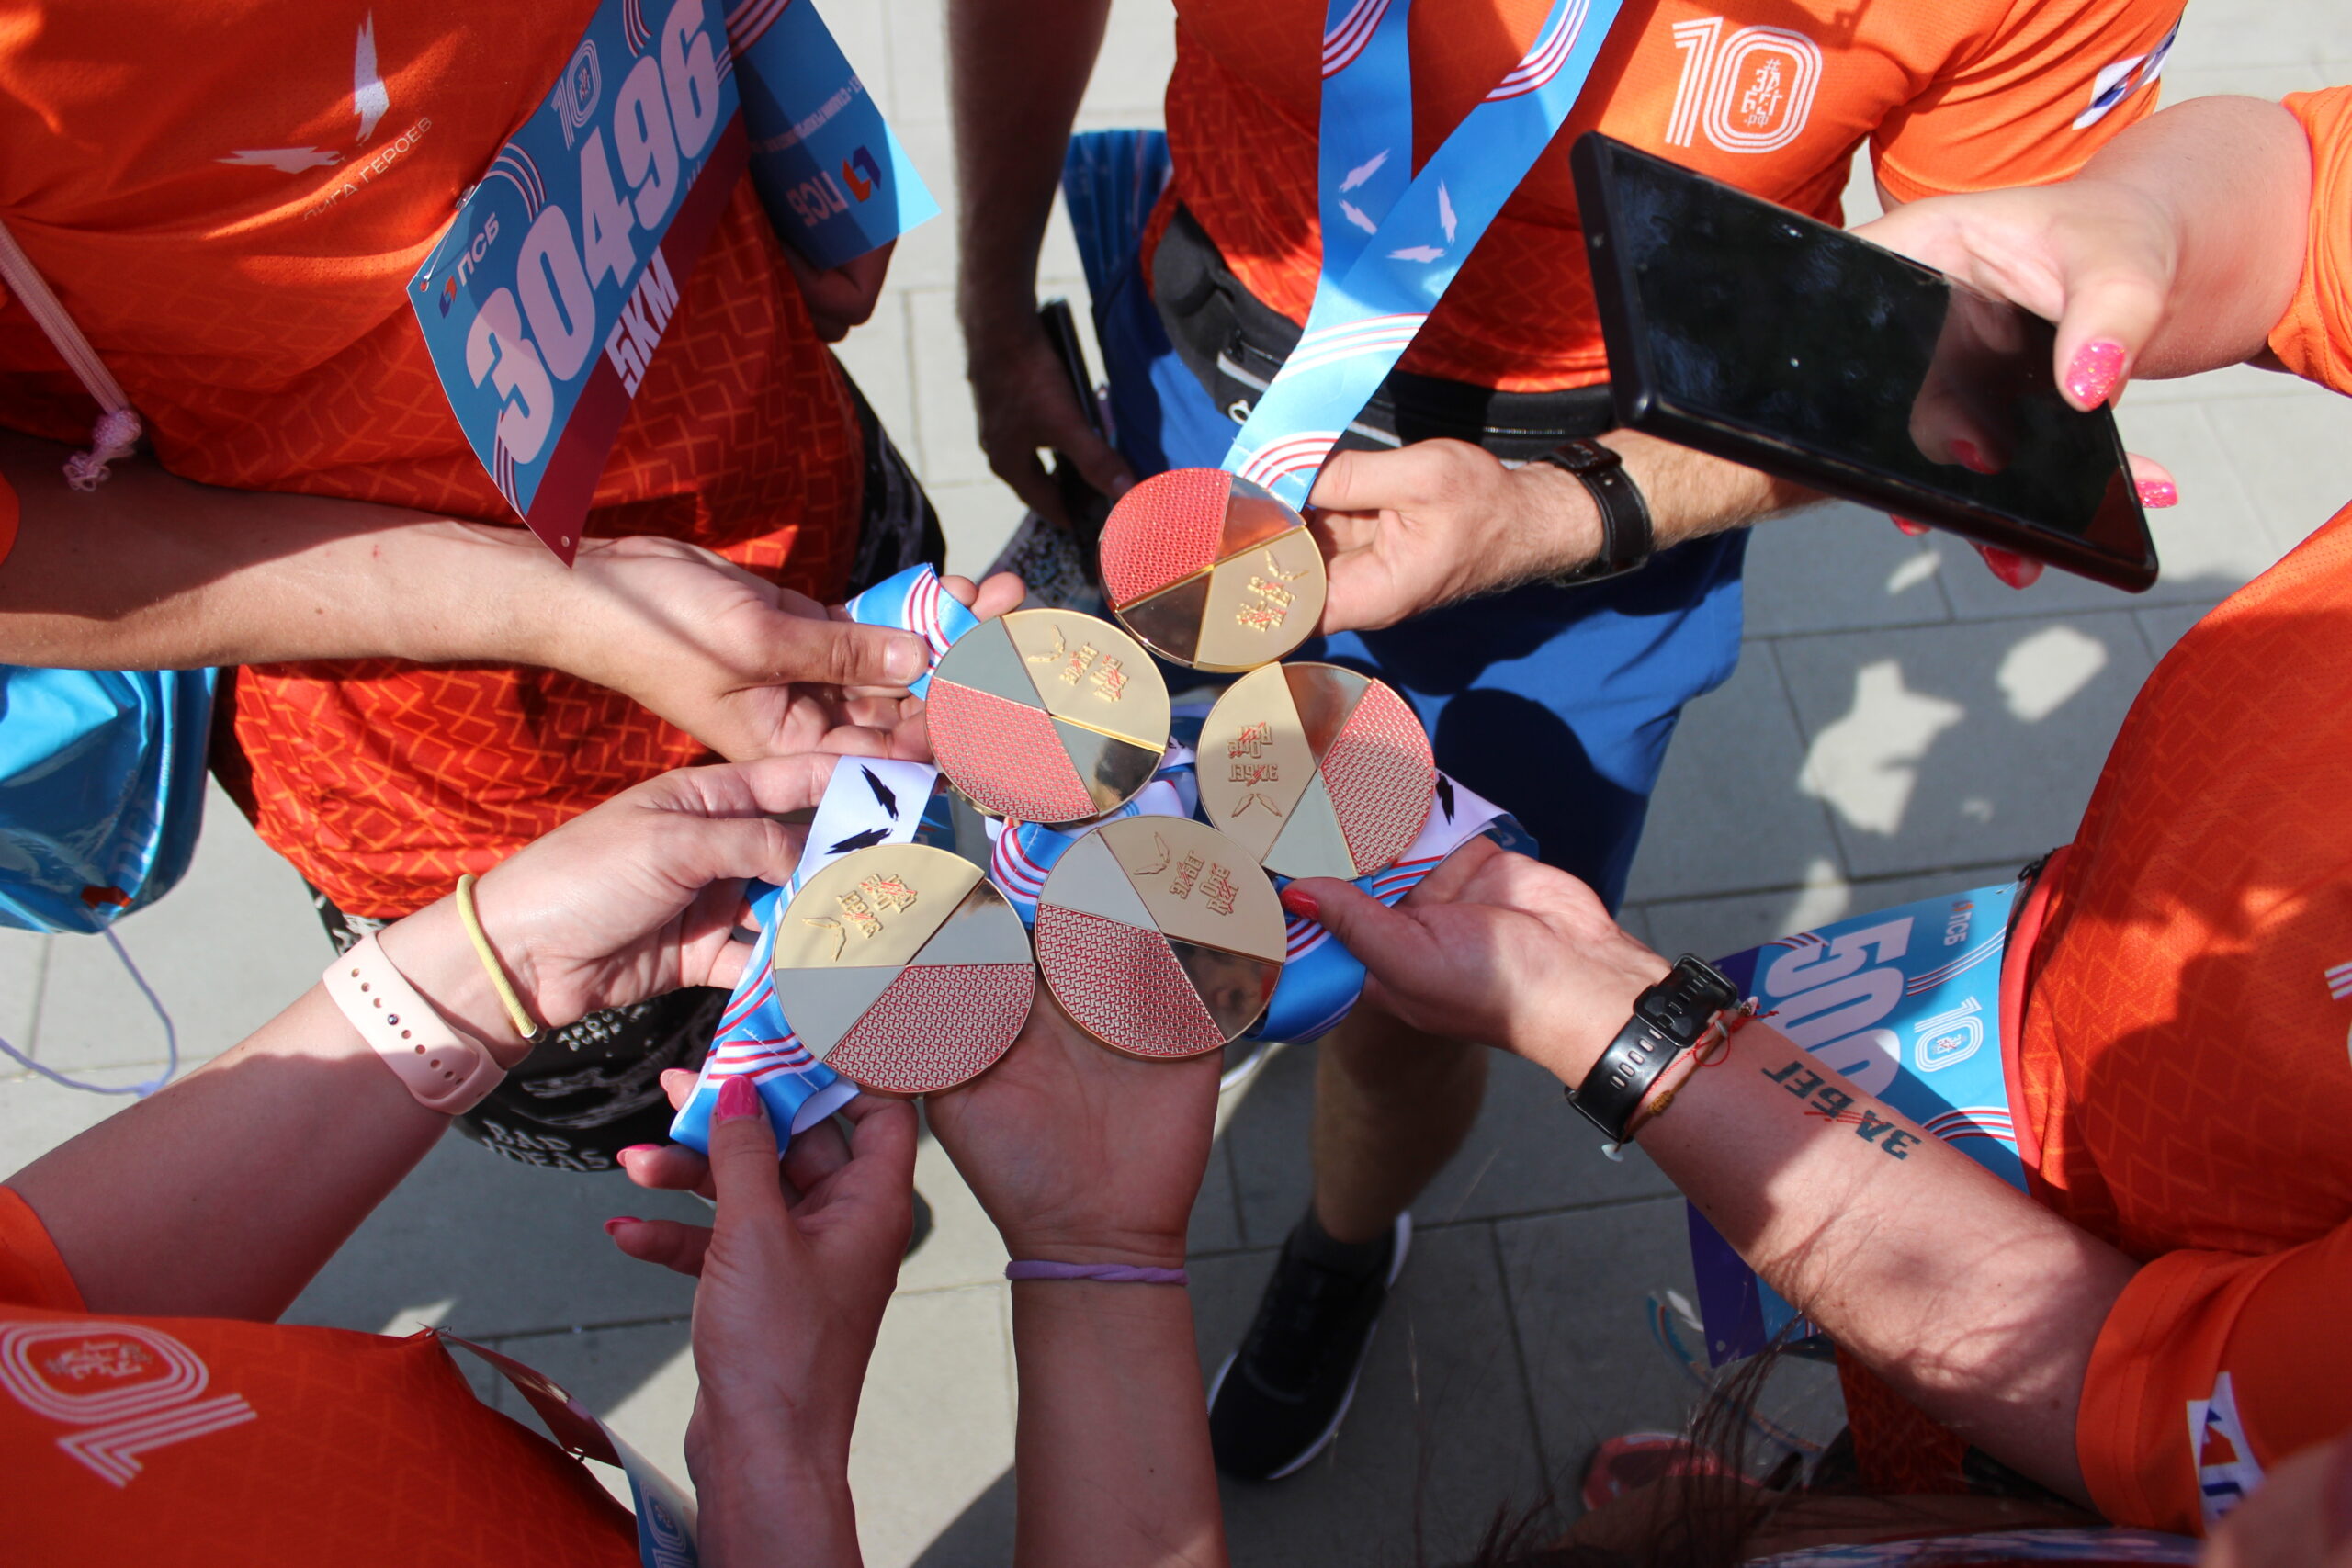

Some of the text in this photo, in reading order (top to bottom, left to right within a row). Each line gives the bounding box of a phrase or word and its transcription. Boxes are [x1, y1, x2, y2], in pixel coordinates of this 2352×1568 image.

[1665, 16, 1823, 154] 10
[359, 117, 433, 183] ГЕРОЕВ
[456, 211, 500, 287] ПСБ
[466, 0, 719, 464] 30496
[1943, 912, 1972, 946] ПСБ
[1914, 996, 1983, 1073] 10
[1761, 1060, 1922, 1161] ЗАБЕГ
